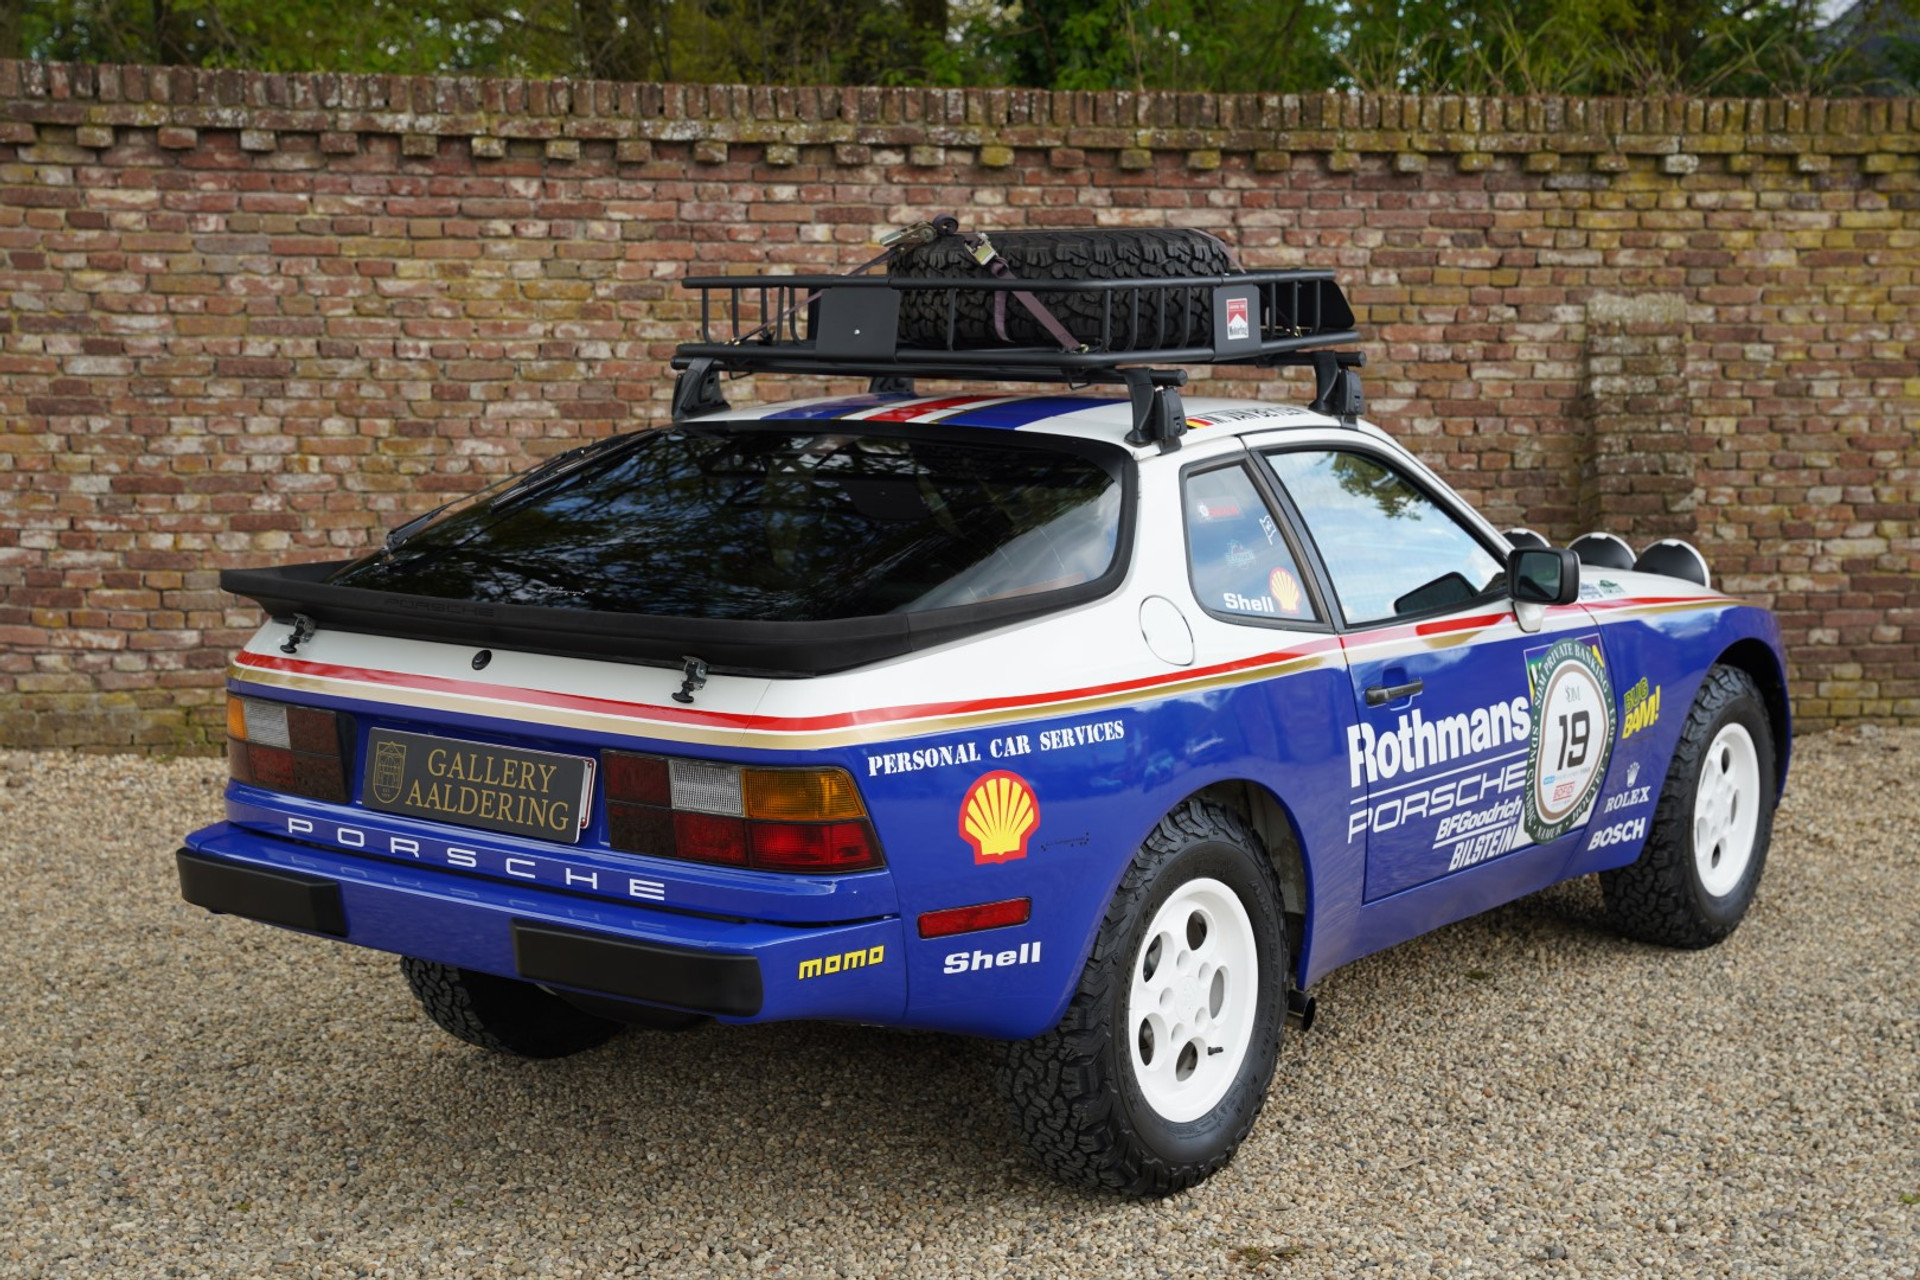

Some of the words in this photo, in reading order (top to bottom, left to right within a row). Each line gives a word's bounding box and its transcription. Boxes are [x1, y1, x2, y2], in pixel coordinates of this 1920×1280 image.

[385, 599, 495, 617] PORSCHE
[1223, 592, 1275, 613] Shell
[1543, 642, 1574, 676] PRIVATE
[1574, 644, 1609, 693] BANKING
[1622, 685, 1660, 739] BAM!
[1624, 676, 1649, 715] BUG
[868, 740, 981, 777] PERSONAL
[990, 734, 1032, 759] CAR
[1040, 719, 1125, 751] SERVICES
[1347, 696, 1532, 789] Rothmans
[1529, 725, 1539, 763] SDM
[1557, 709, 1590, 771] 19
[427, 748, 558, 794] GALLERY
[405, 779, 570, 831] AALDERING
[1347, 760, 1528, 844] PORSCHE
[1435, 795, 1523, 842] BFGoodrich
[1604, 786, 1651, 814] ROLEX
[1448, 824, 1518, 872] BILSTEIN
[1587, 817, 1646, 851] BOSCH
[288, 817, 666, 901] PORSCHE
[798, 945, 885, 980] momo
[944, 941, 1041, 975] Shell
